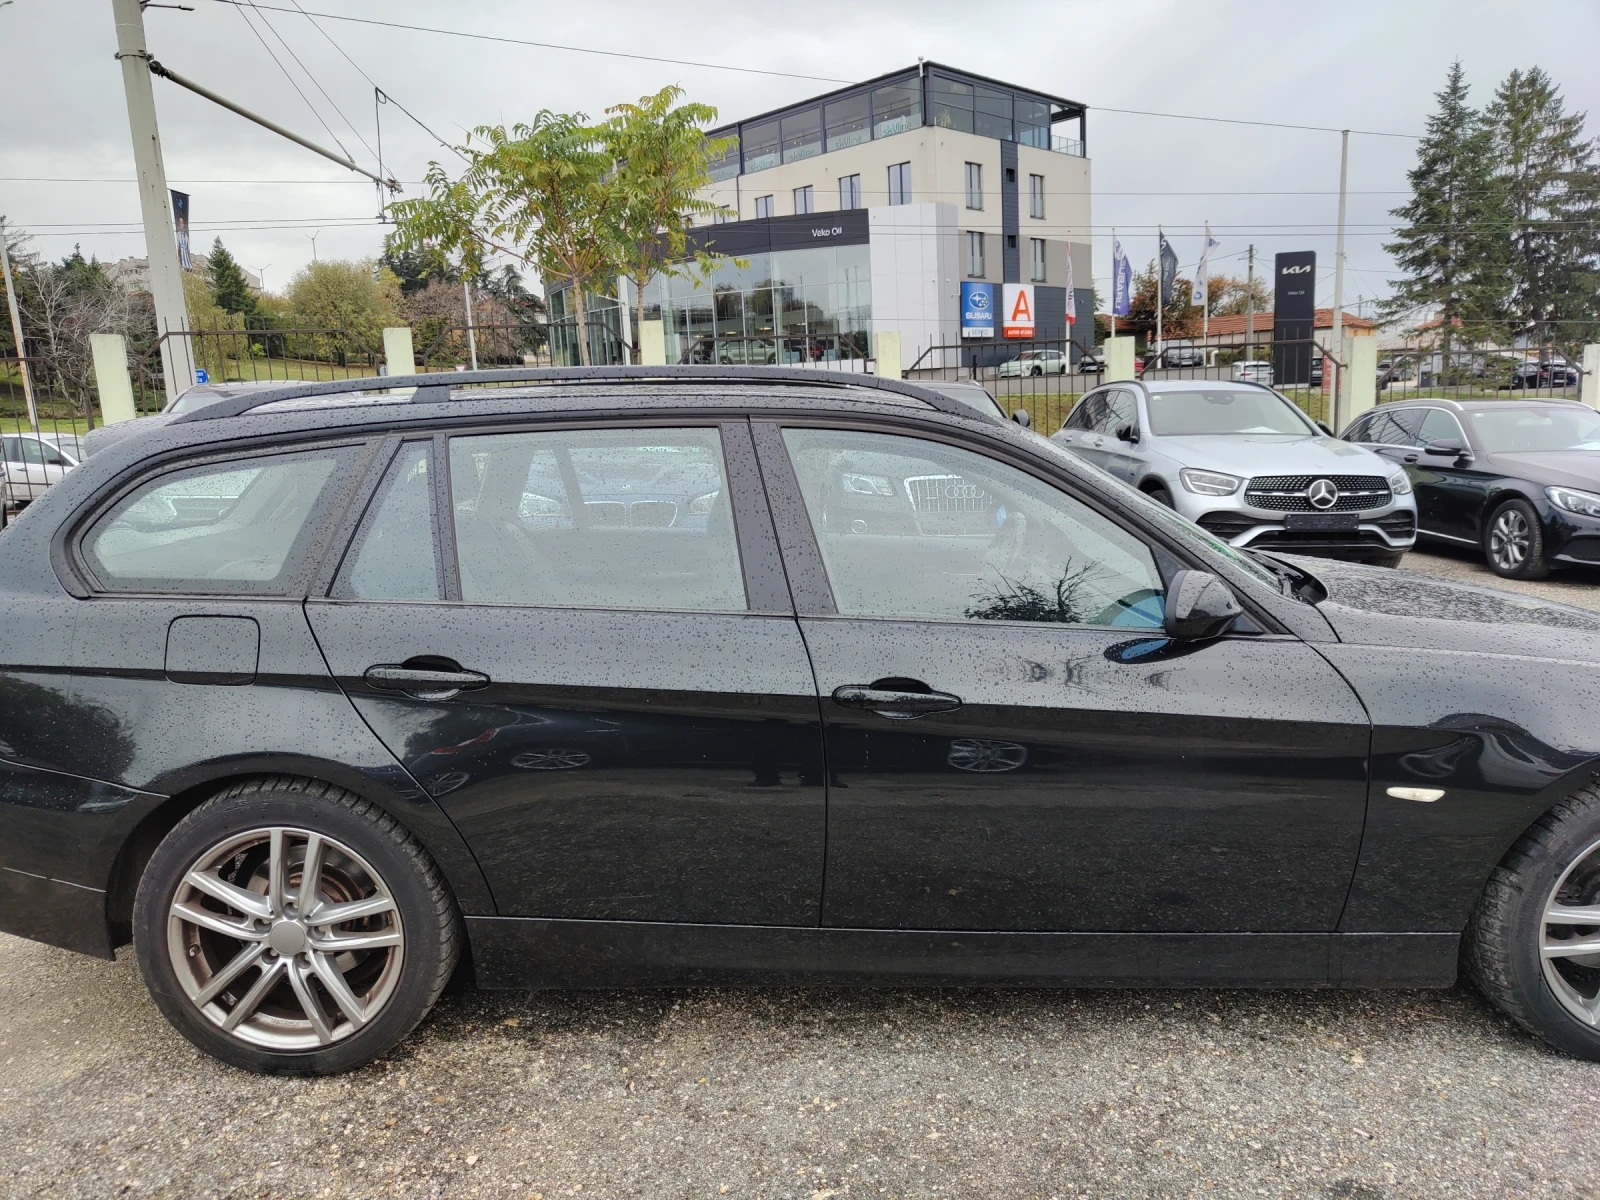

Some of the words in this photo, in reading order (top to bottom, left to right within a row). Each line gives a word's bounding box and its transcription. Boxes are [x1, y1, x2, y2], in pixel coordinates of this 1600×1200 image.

[811, 228, 830, 237] Veko
[831, 227, 843, 236] Oil
[1282, 265, 1311, 275] KIA
[1114, 258, 1127, 309] SUBARU
[965, 312, 992, 320] SUBARU
